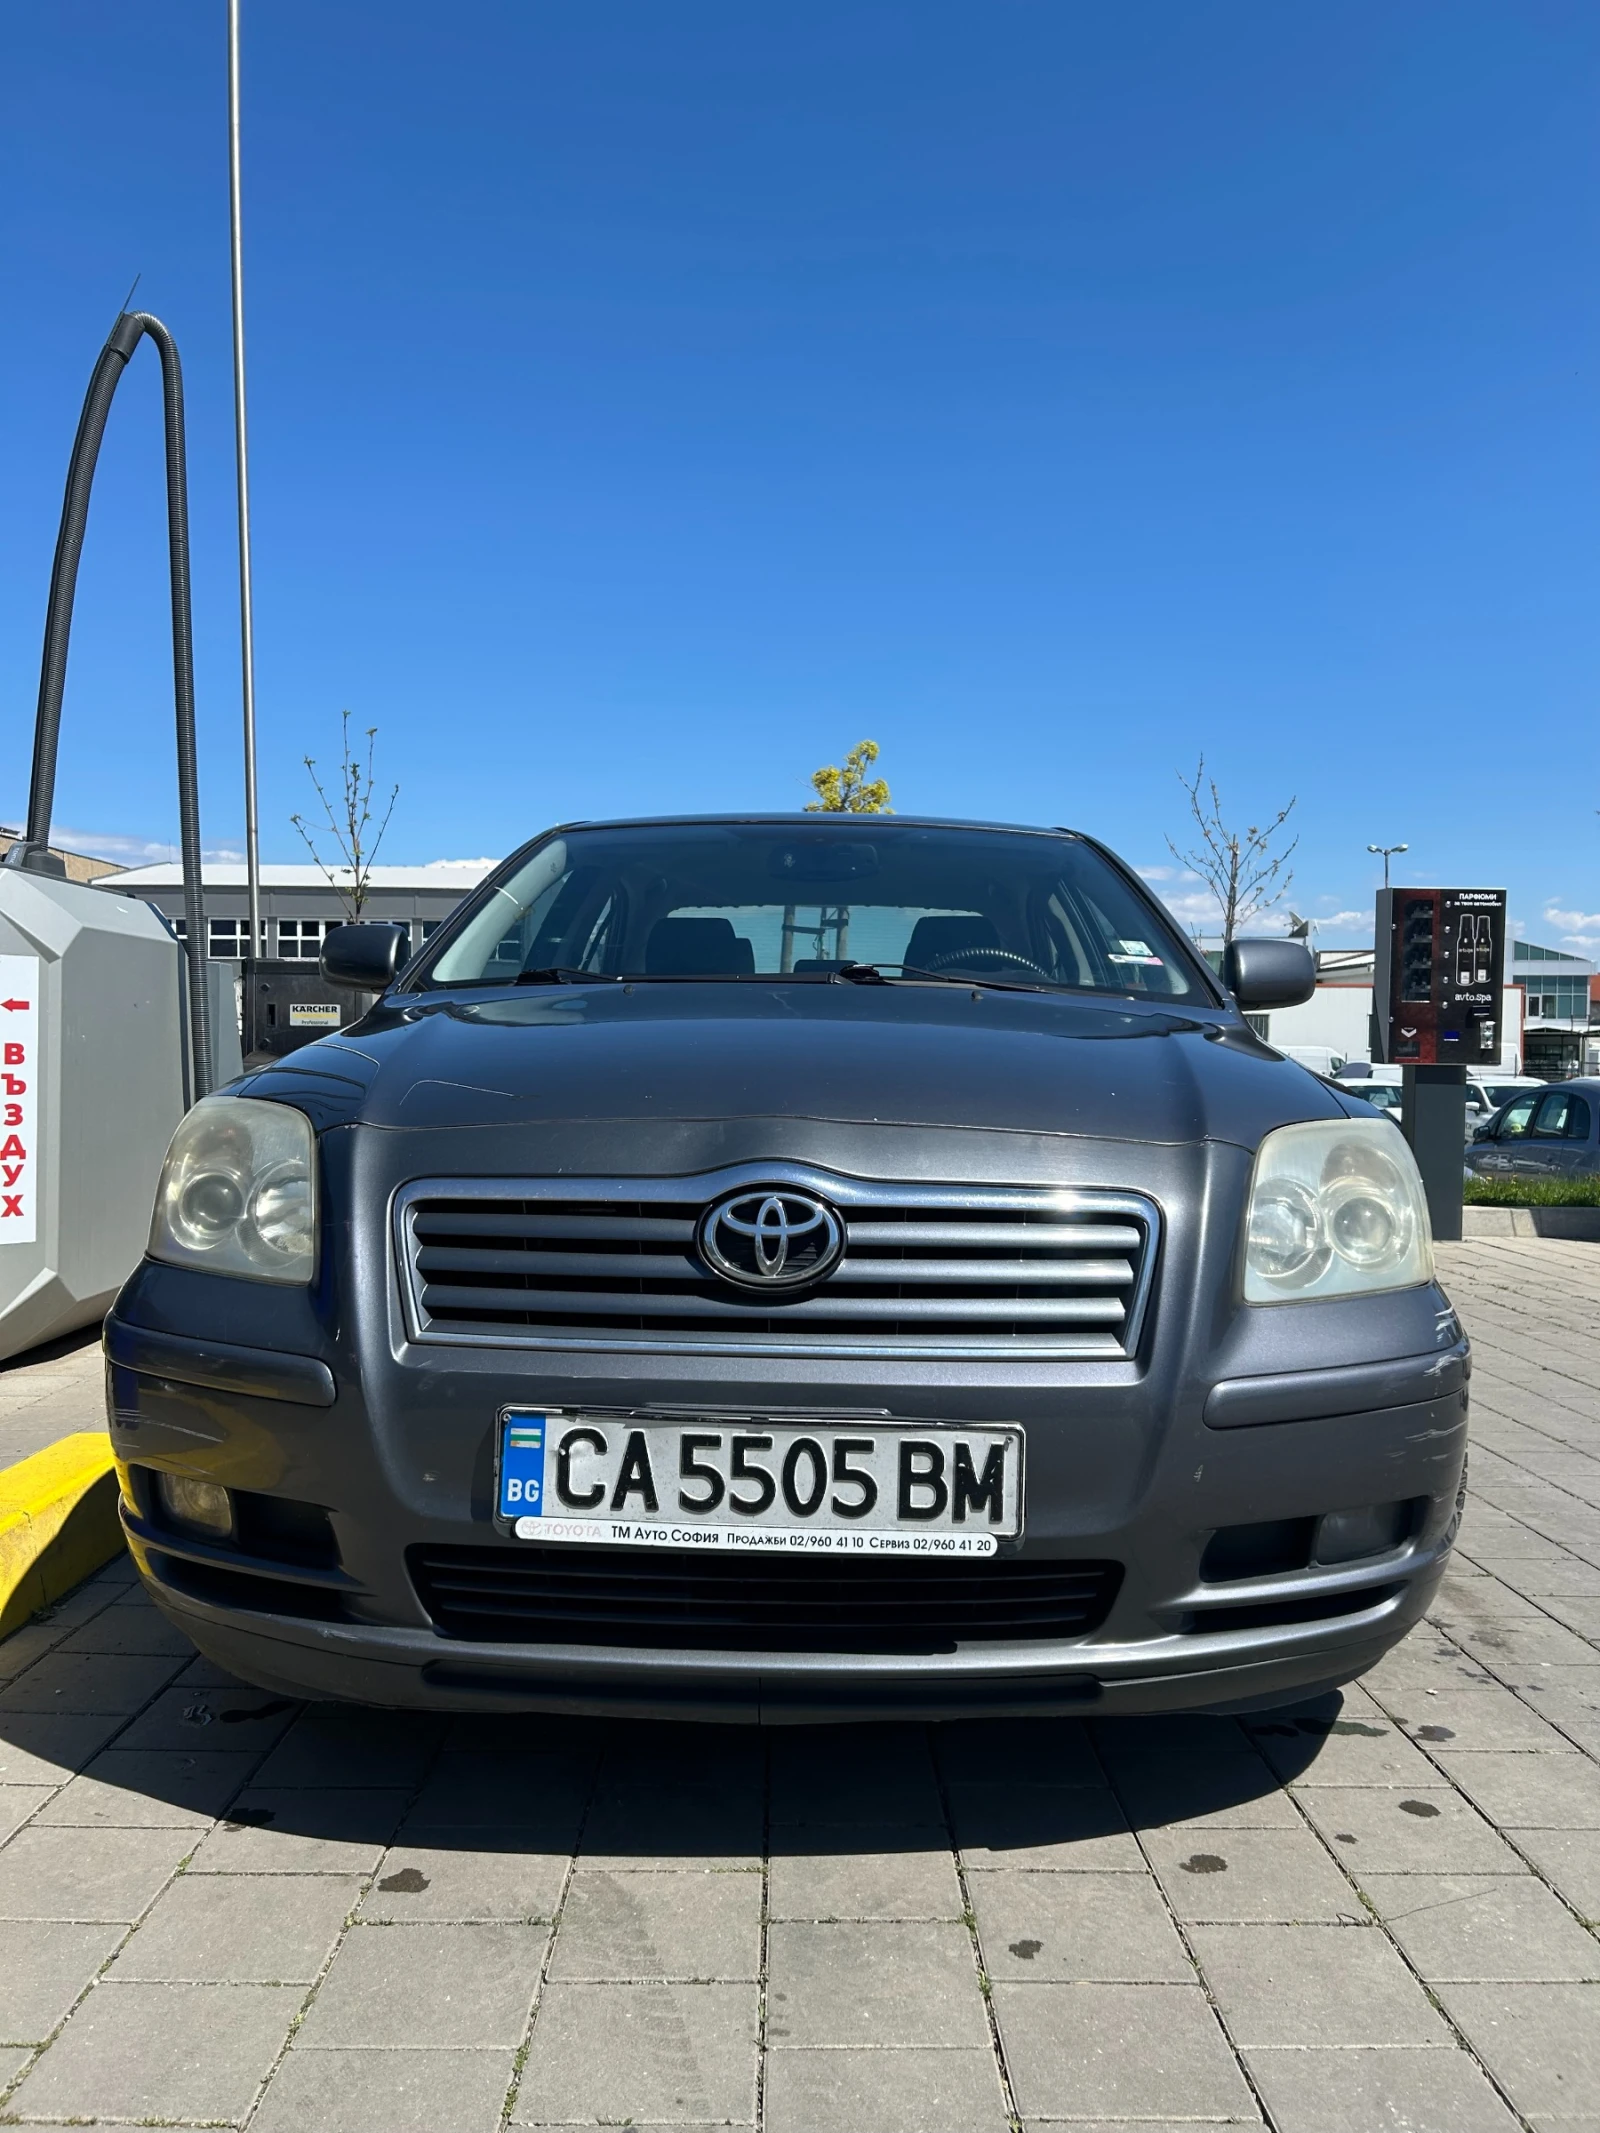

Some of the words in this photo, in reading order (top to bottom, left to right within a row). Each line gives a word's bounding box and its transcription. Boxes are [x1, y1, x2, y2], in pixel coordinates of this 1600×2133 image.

[0, 1043, 27, 1217] ВЪЗДУХ
[506, 1479, 539, 1502] BG
[556, 1427, 659, 1512] CA
[678, 1433, 879, 1518] 5505
[897, 1438, 1005, 1524] BM
[545, 1522, 601, 1537] TOYOTA
[790, 1535, 832, 1548] 02/960
[836, 1537, 848, 1548] 41
[852, 1537, 864, 1548] 10
[913, 1538, 955, 1551] 02/960
[959, 1540, 972, 1551] 41
[977, 1540, 991, 1551] 20
